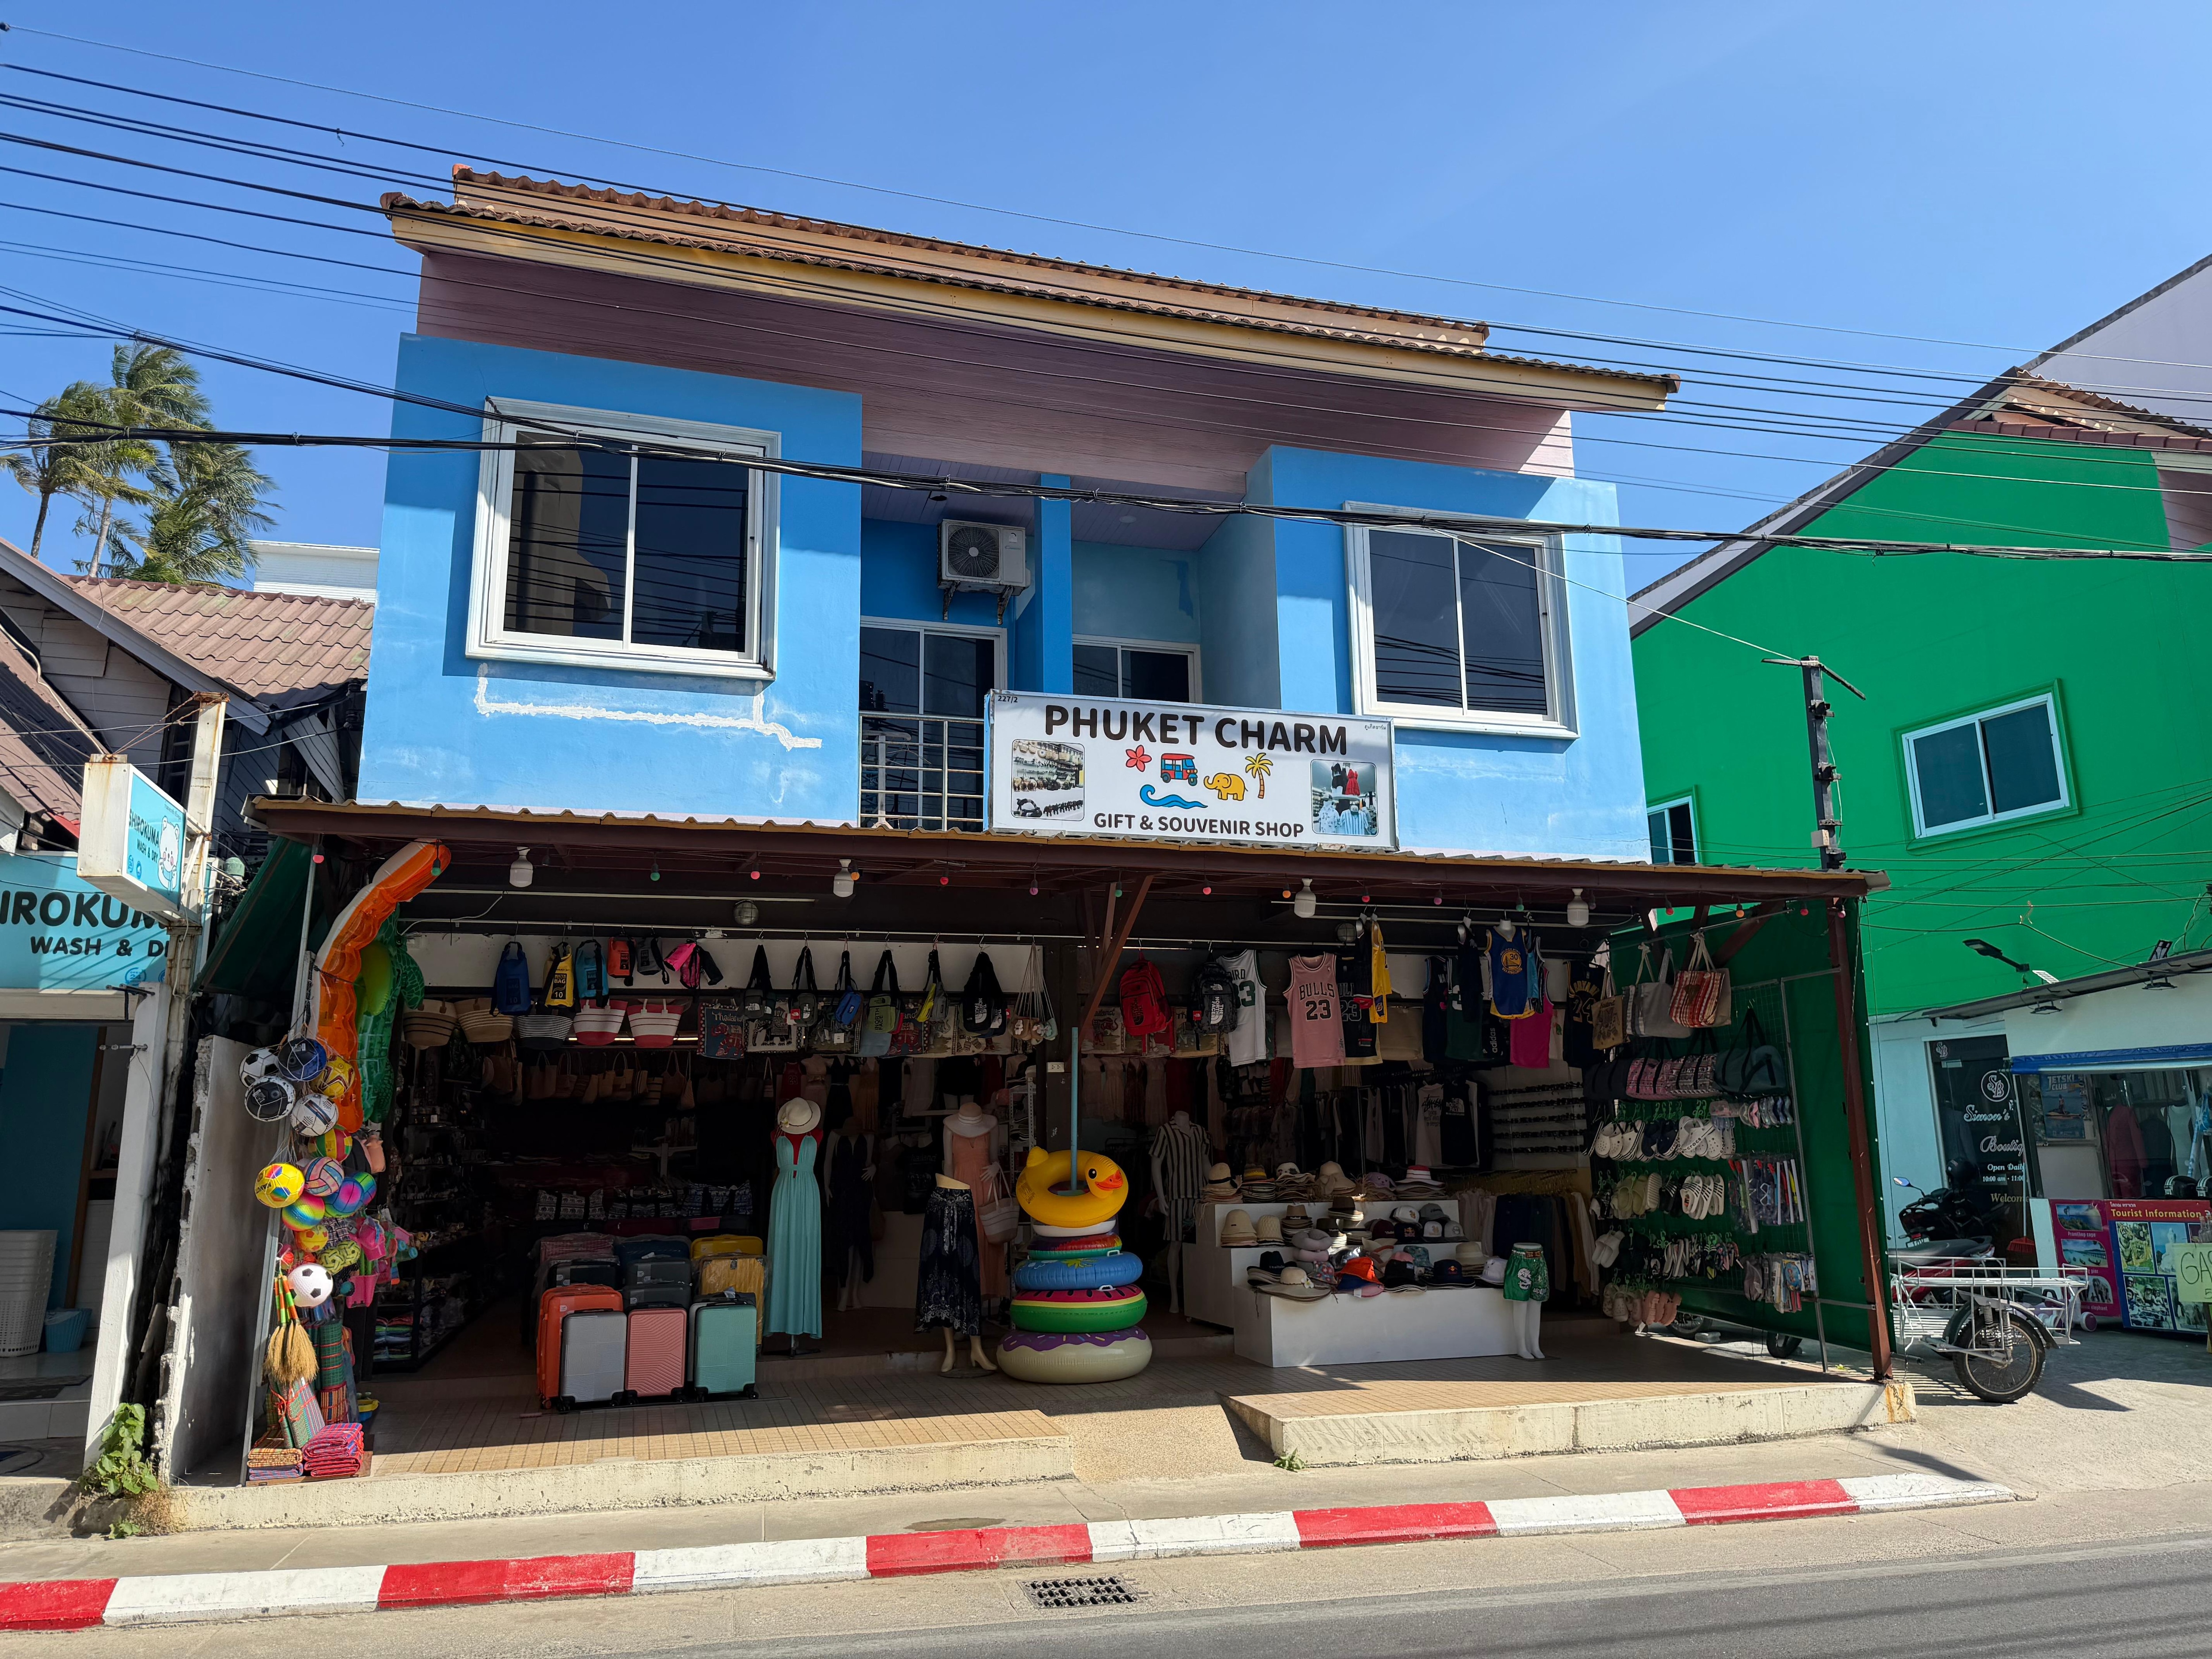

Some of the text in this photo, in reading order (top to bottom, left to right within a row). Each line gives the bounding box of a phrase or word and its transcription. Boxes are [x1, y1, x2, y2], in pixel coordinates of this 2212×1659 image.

[1045, 705, 1347, 755] PHUKET CHARM
[129, 809, 159, 848] SHIROKUMA
[1094, 813, 1304, 837] GIFT & SOUVENIR SHOP
[137, 839, 146, 856] WASH
[147, 847, 151, 859] &
[31, 936, 101, 955] WASH
[116, 939, 133, 956] &
[1299, 982, 1334, 1000] BULLS
[1306, 999, 1331, 1021] 23
[1490, 1027, 1498, 1053] adidas
[2047, 1074, 2074, 1091] JETSKI
[1963, 1104, 2010, 1122] Simon's
[1686, 1137, 1701, 1150] crocs
[1980, 1135, 2024, 1157] Boutiq
[1987, 1164, 2005, 1172] Open
[2111, 1209, 2143, 1217] Tourist
[2145, 1209, 2202, 1217] Information
[2181, 1252, 2212, 1285] GA
